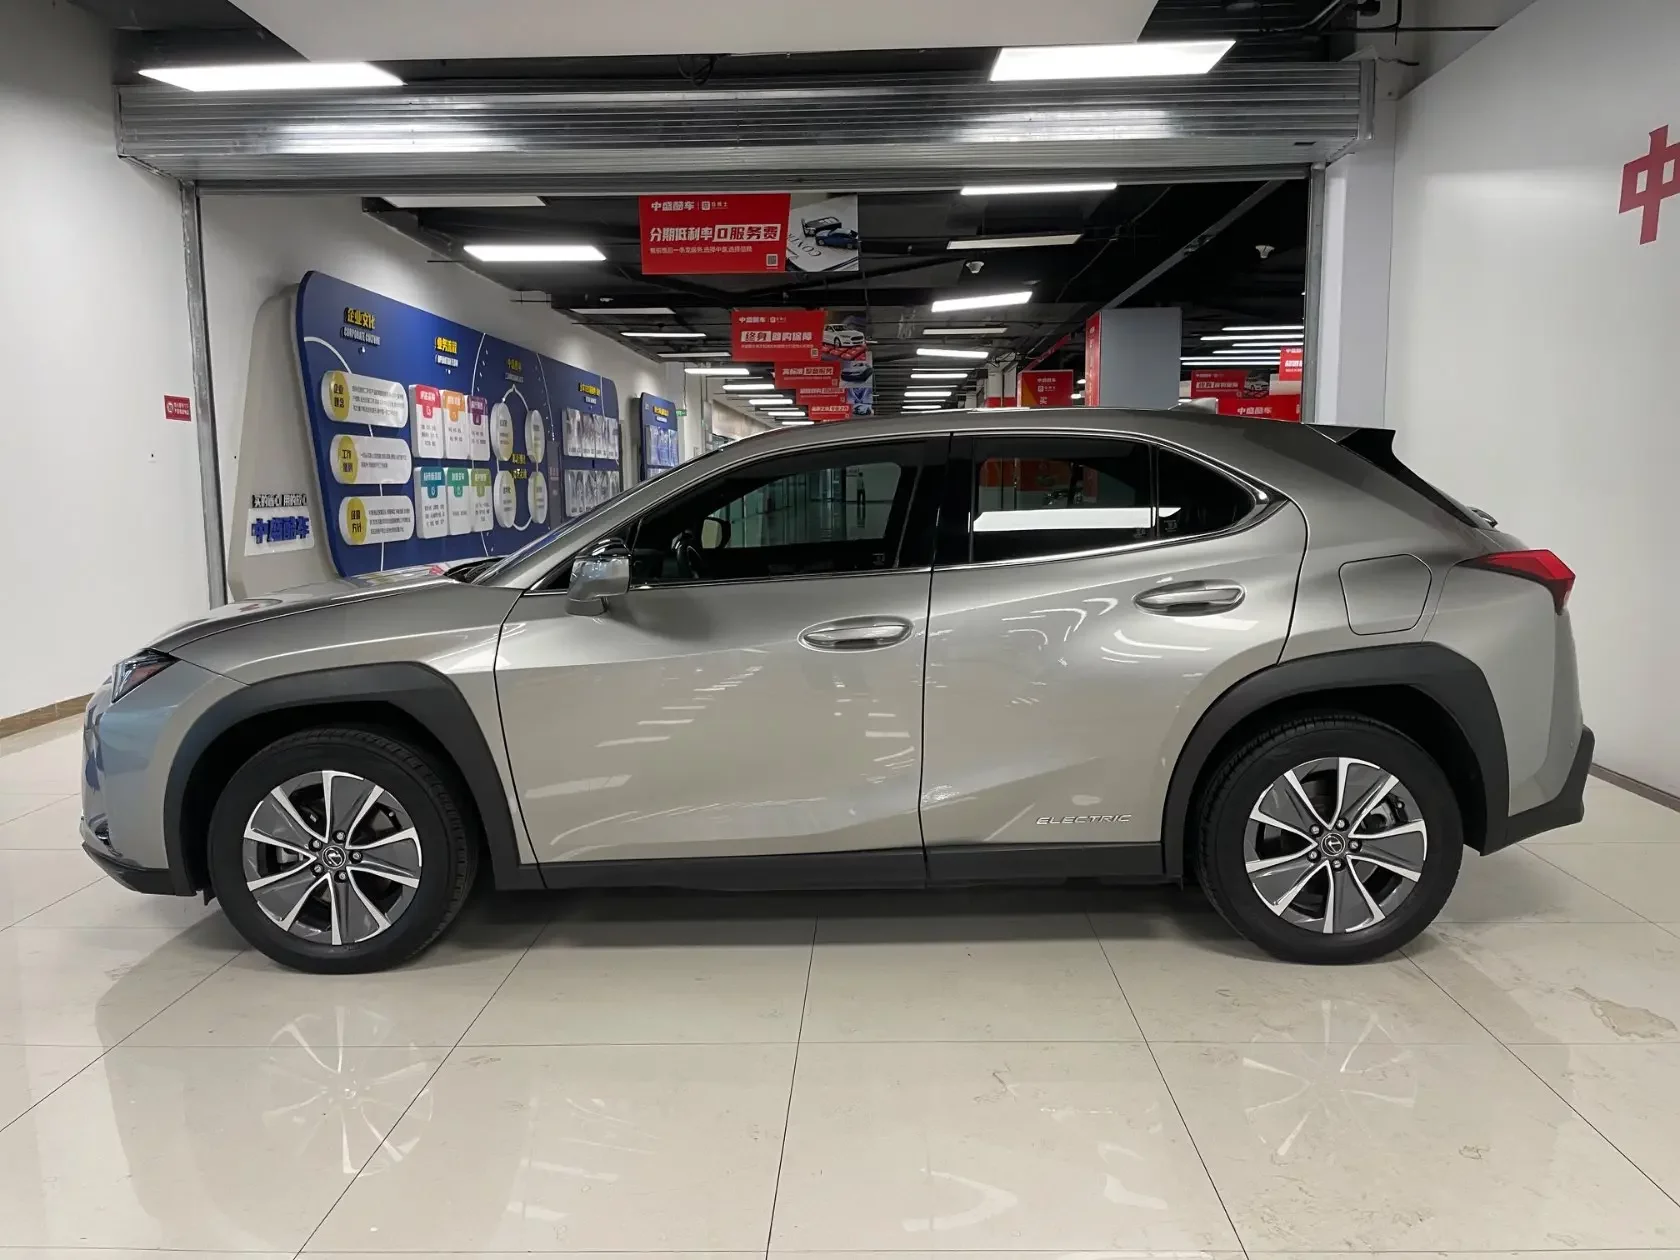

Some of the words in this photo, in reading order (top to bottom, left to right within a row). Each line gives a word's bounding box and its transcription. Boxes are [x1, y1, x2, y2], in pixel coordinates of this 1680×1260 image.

[651, 201, 695, 211] 中盛酷车
[347, 307, 376, 330] 企业文化
[1036, 814, 1132, 825] ELECTRIC
